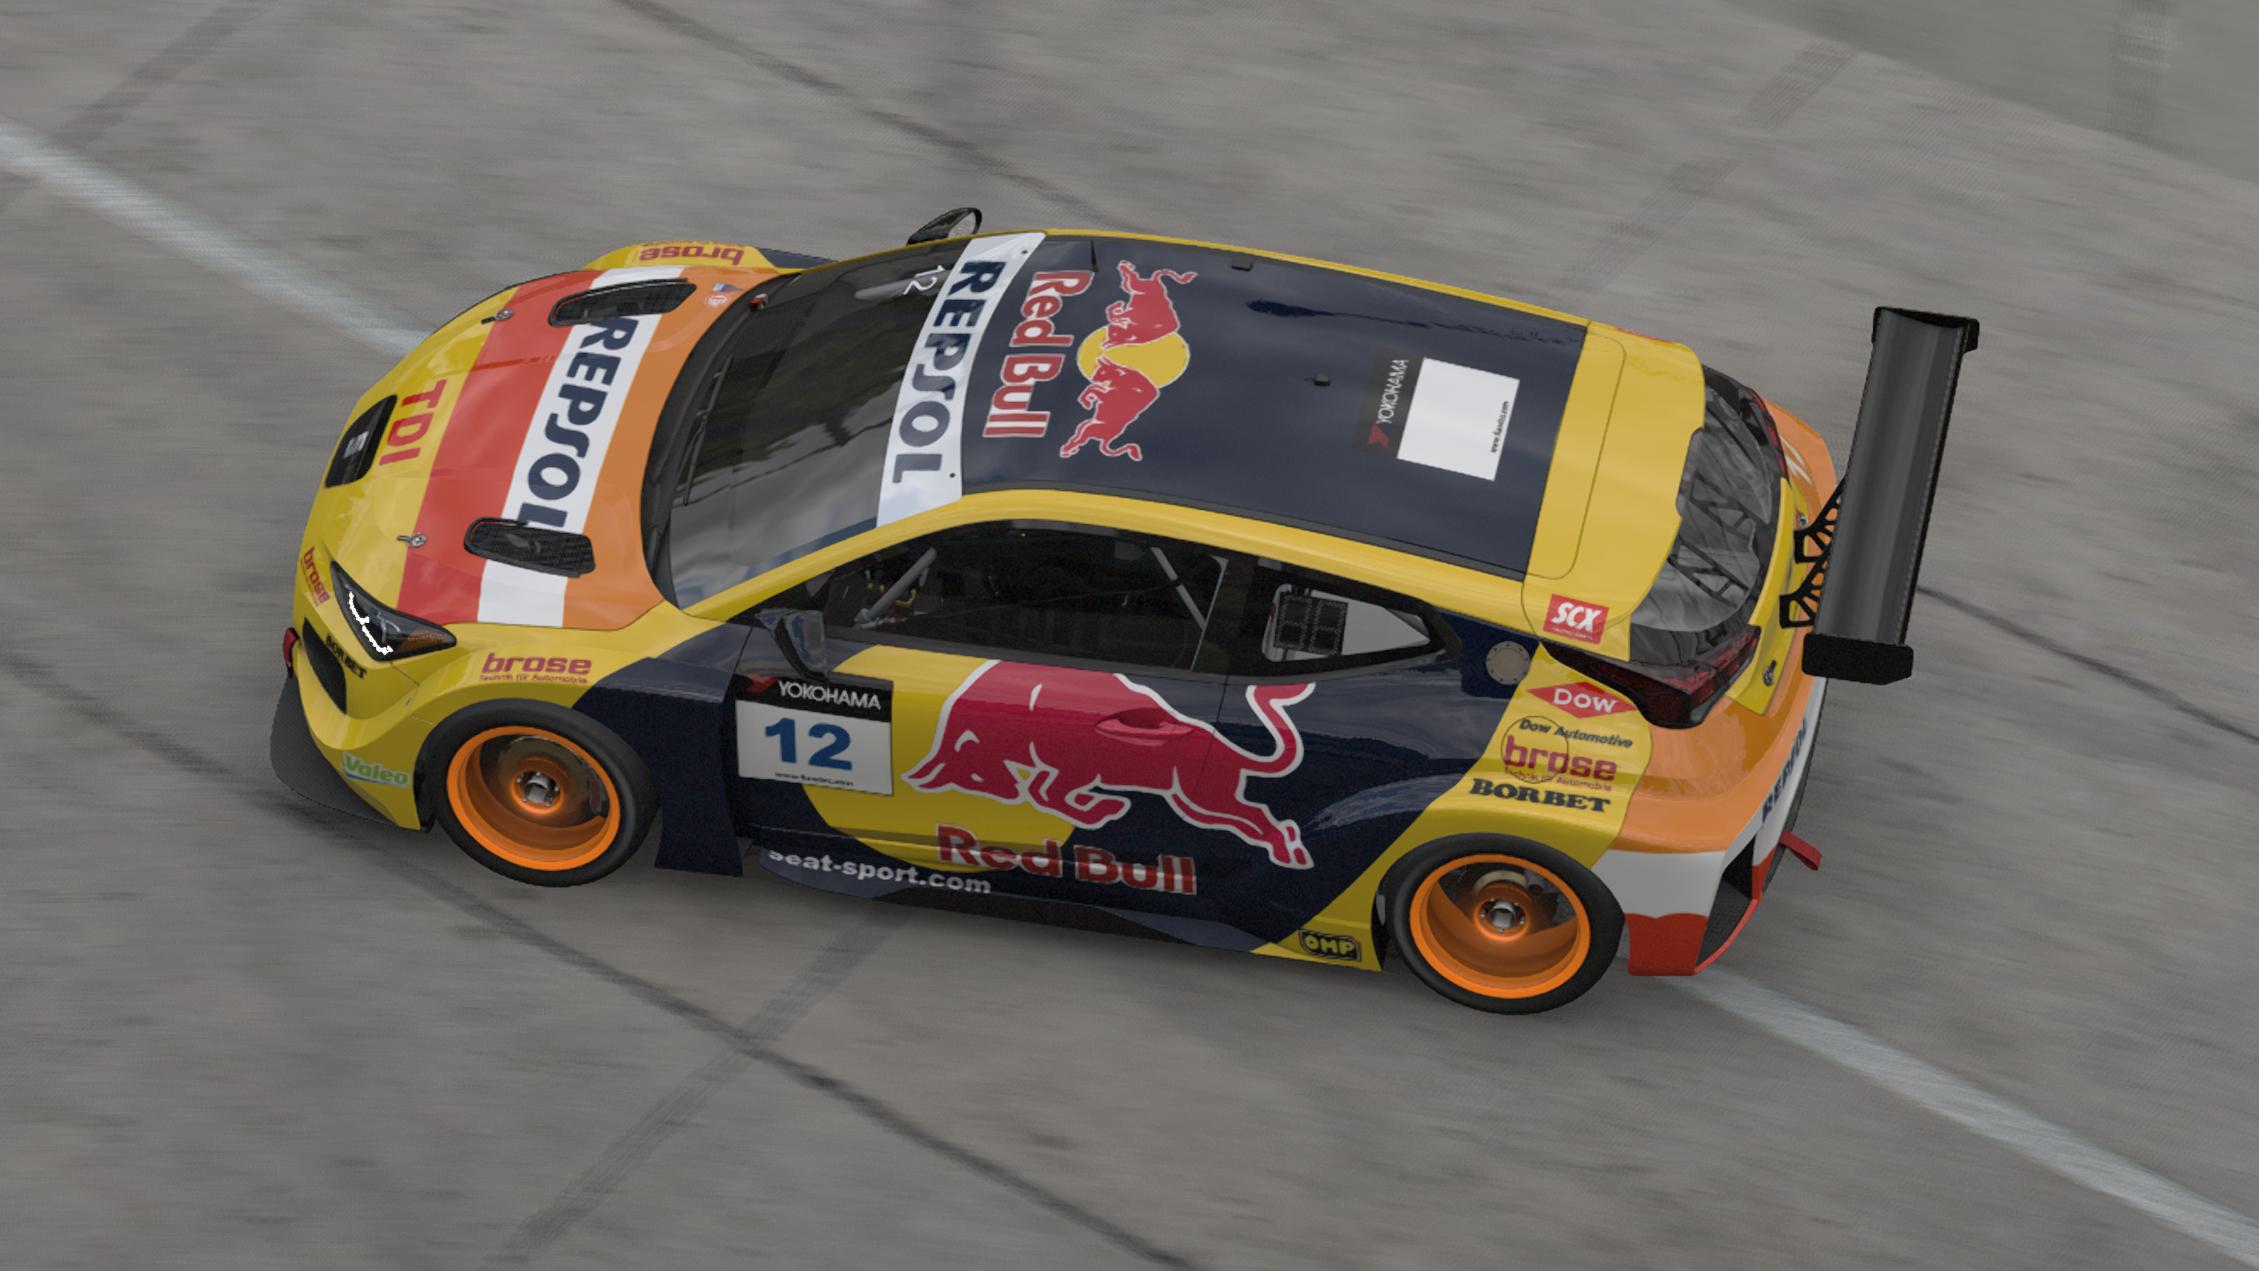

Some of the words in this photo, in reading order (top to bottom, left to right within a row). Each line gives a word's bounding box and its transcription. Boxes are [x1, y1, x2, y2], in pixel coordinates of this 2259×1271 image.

[639, 245, 744, 266] brose
[903, 264, 946, 296] 12
[1009, 270, 1095, 347] Red
[892, 260, 1007, 484] REPSOL
[982, 353, 1066, 437] Bull
[1375, 359, 1409, 424] YOKOHAMA
[379, 378, 448, 466] TDI
[303, 545, 330, 604] brose
[1551, 601, 1603, 633] SCX
[481, 652, 592, 676] brose
[778, 680, 881, 711] YOKOHAMA
[1553, 687, 1617, 714] DOW
[765, 717, 852, 771] 12
[1519, 719, 1551, 735] Dow
[1554, 726, 1634, 749] Automotive
[344, 753, 409, 785] Valeo
[1503, 735, 1618, 782] brose
[1469, 778, 1612, 813] BORBET
[935, 823, 1063, 879] Red
[1073, 844, 1198, 895] Bull
[1303, 934, 1356, 956] OMP
